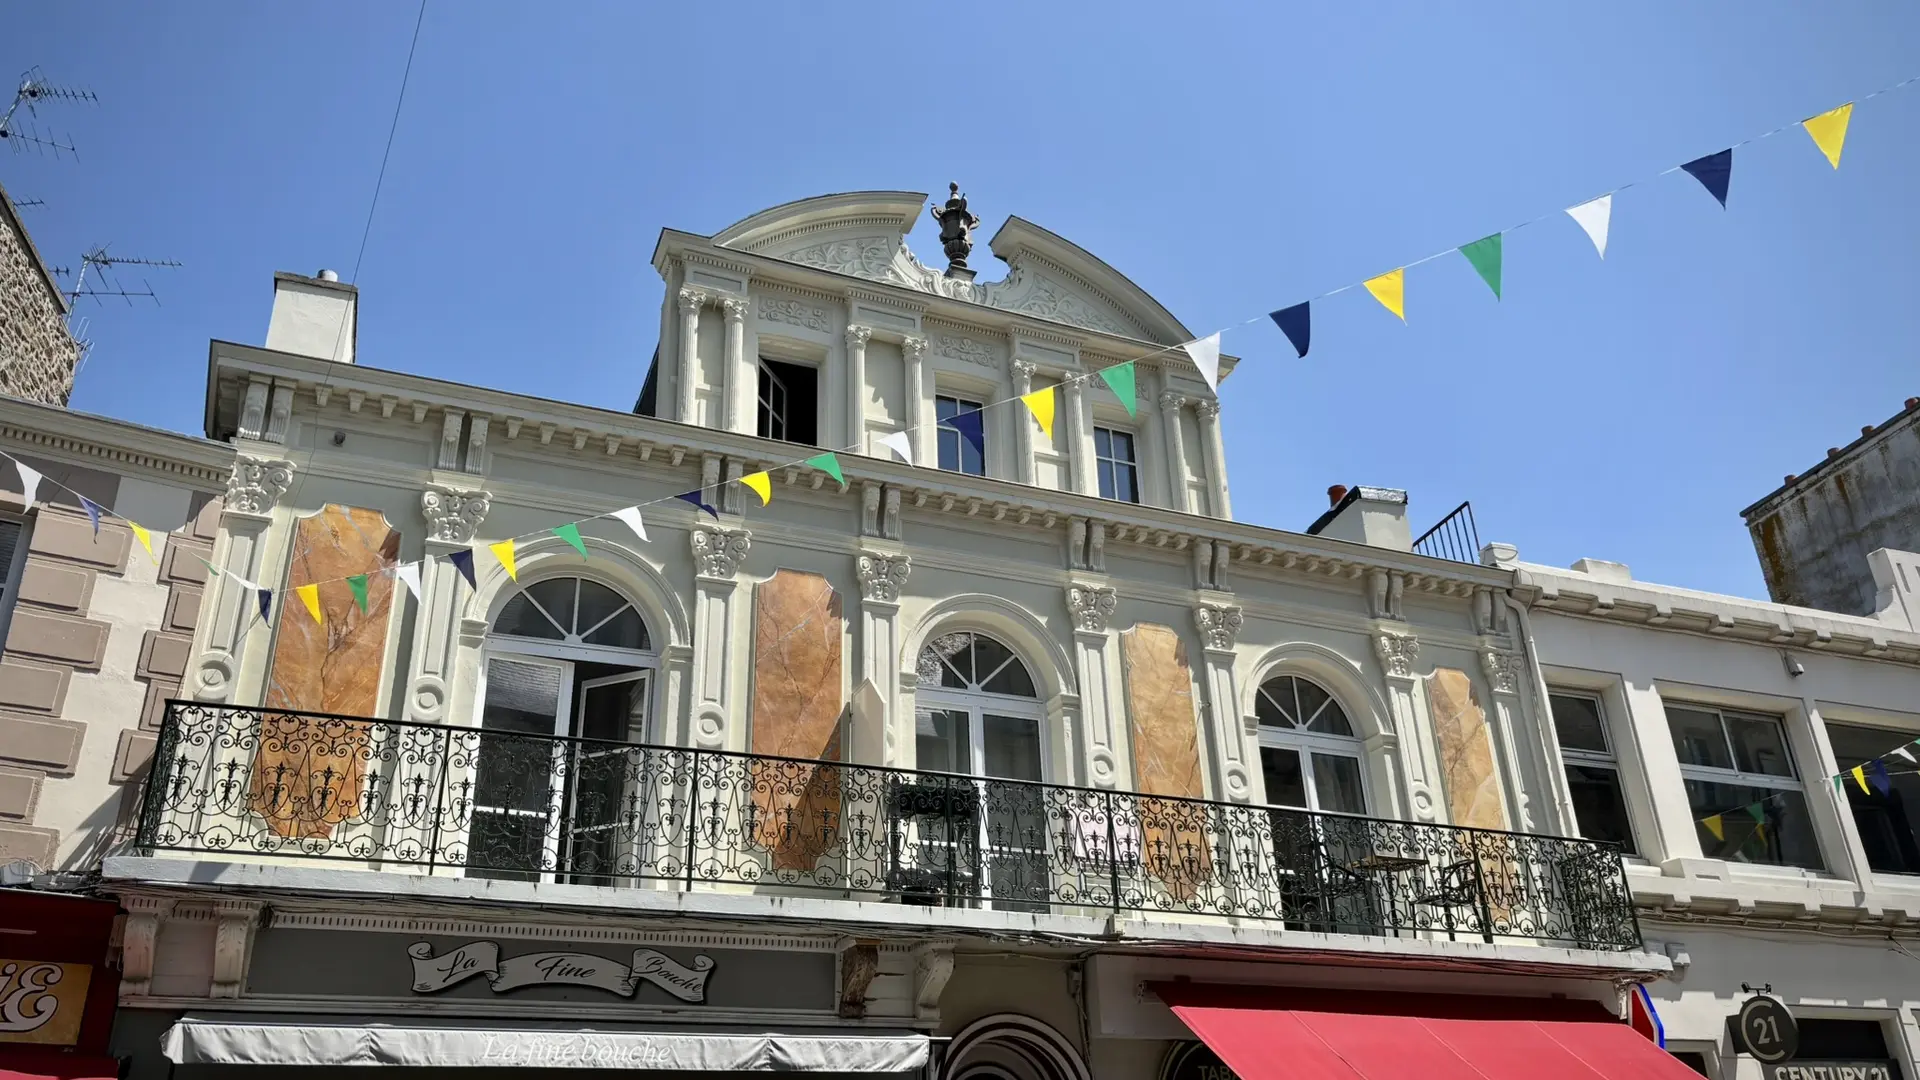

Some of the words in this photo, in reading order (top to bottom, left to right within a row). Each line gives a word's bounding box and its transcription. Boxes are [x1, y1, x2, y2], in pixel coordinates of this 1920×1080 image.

[437, 951, 479, 983] La
[534, 954, 596, 979] Fine
[633, 956, 701, 993] Bouche
[482, 1035, 518, 1060] La
[524, 1036, 577, 1066] fine
[581, 1037, 672, 1063] bouche
